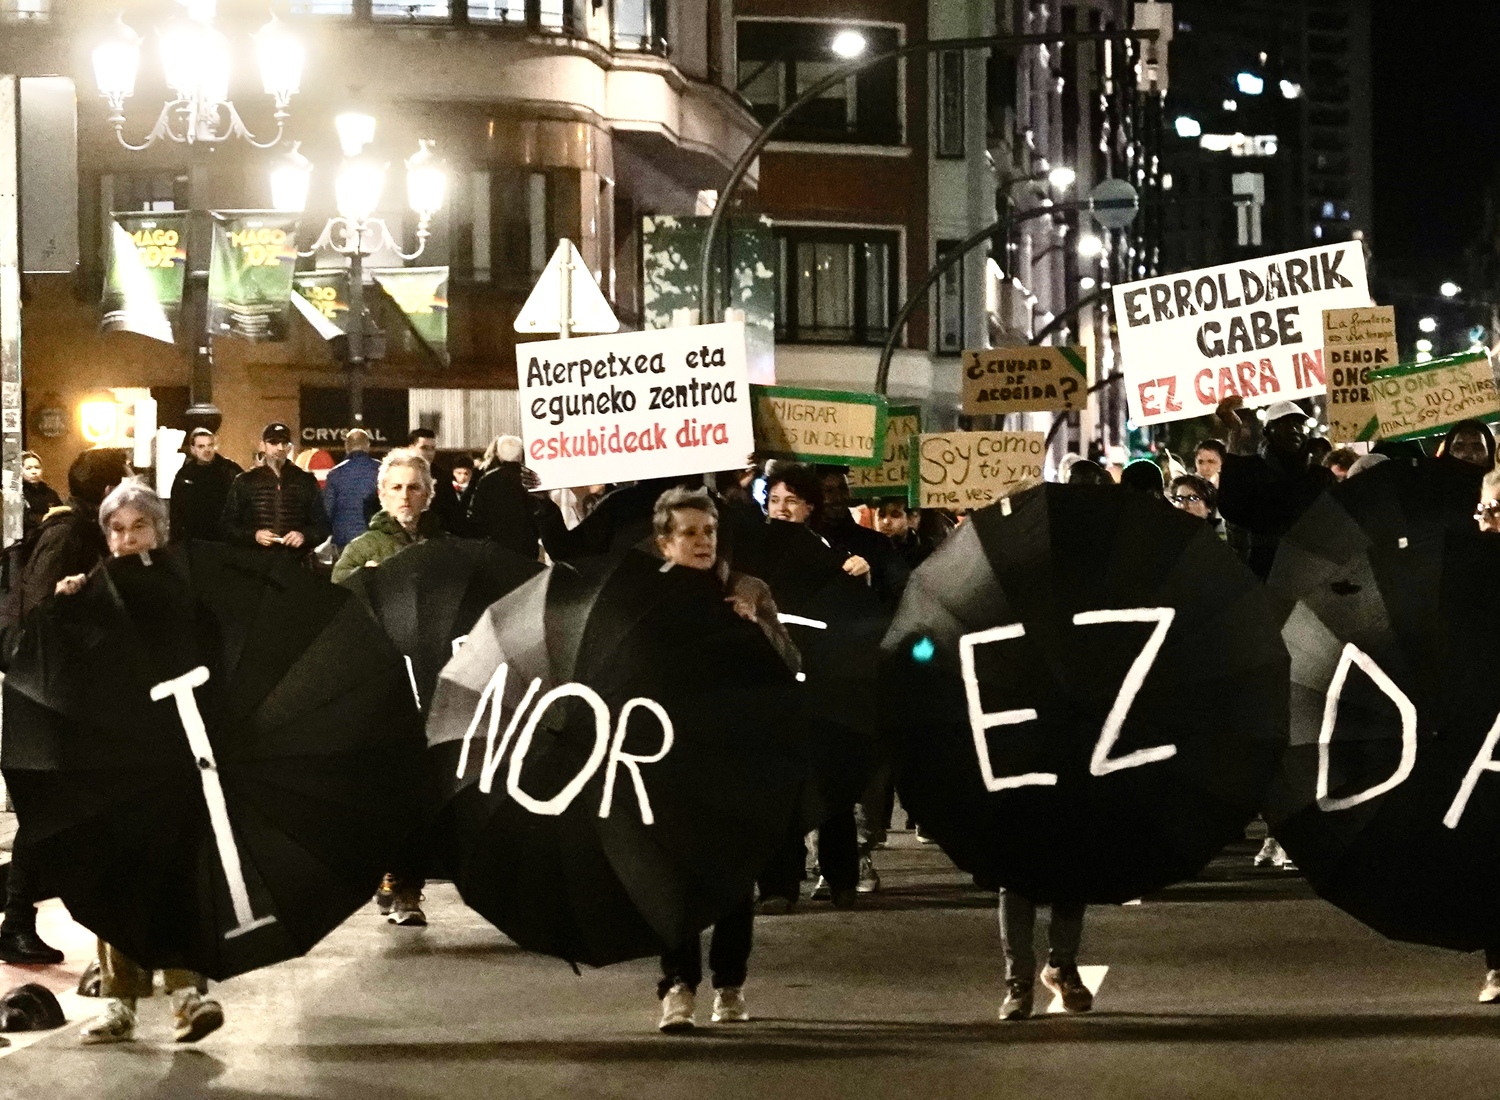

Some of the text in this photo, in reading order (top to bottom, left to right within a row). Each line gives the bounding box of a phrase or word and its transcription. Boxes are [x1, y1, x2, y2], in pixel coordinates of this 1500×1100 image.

[231, 228, 287, 247] MAGO
[1123, 249, 1354, 328] ERROLDARIK
[1196, 305, 1303, 359] GABE
[1326, 312, 1348, 330] La
[527, 346, 726, 388] Aterpetxea eta
[1331, 348, 1389, 364] DENOK
[1006, 374, 1026, 386] DE
[1137, 348, 1327, 417] EZ GARA IN
[1333, 365, 1380, 387] ONG
[1371, 378, 1401, 402] NO
[1404, 372, 1440, 393] ONE
[530, 377, 738, 426] eguneko zentroa
[976, 377, 1079, 408] ACOGIDA?
[1425, 388, 1454, 407] NO
[774, 401, 837, 424] MIGRAR
[302, 427, 388, 441] CRYSAL
[530, 418, 729, 461] eskubideak dira
[803, 429, 819, 446] UN
[825, 430, 875, 450] DELITO
[920, 437, 971, 485] Soy
[978, 459, 1002, 479] tú
[1021, 462, 1042, 478] no
[926, 488, 993, 505] me ves
[959, 606, 1177, 792] EZ
[456, 661, 674, 825] NOR
[150, 665, 273, 938] I
